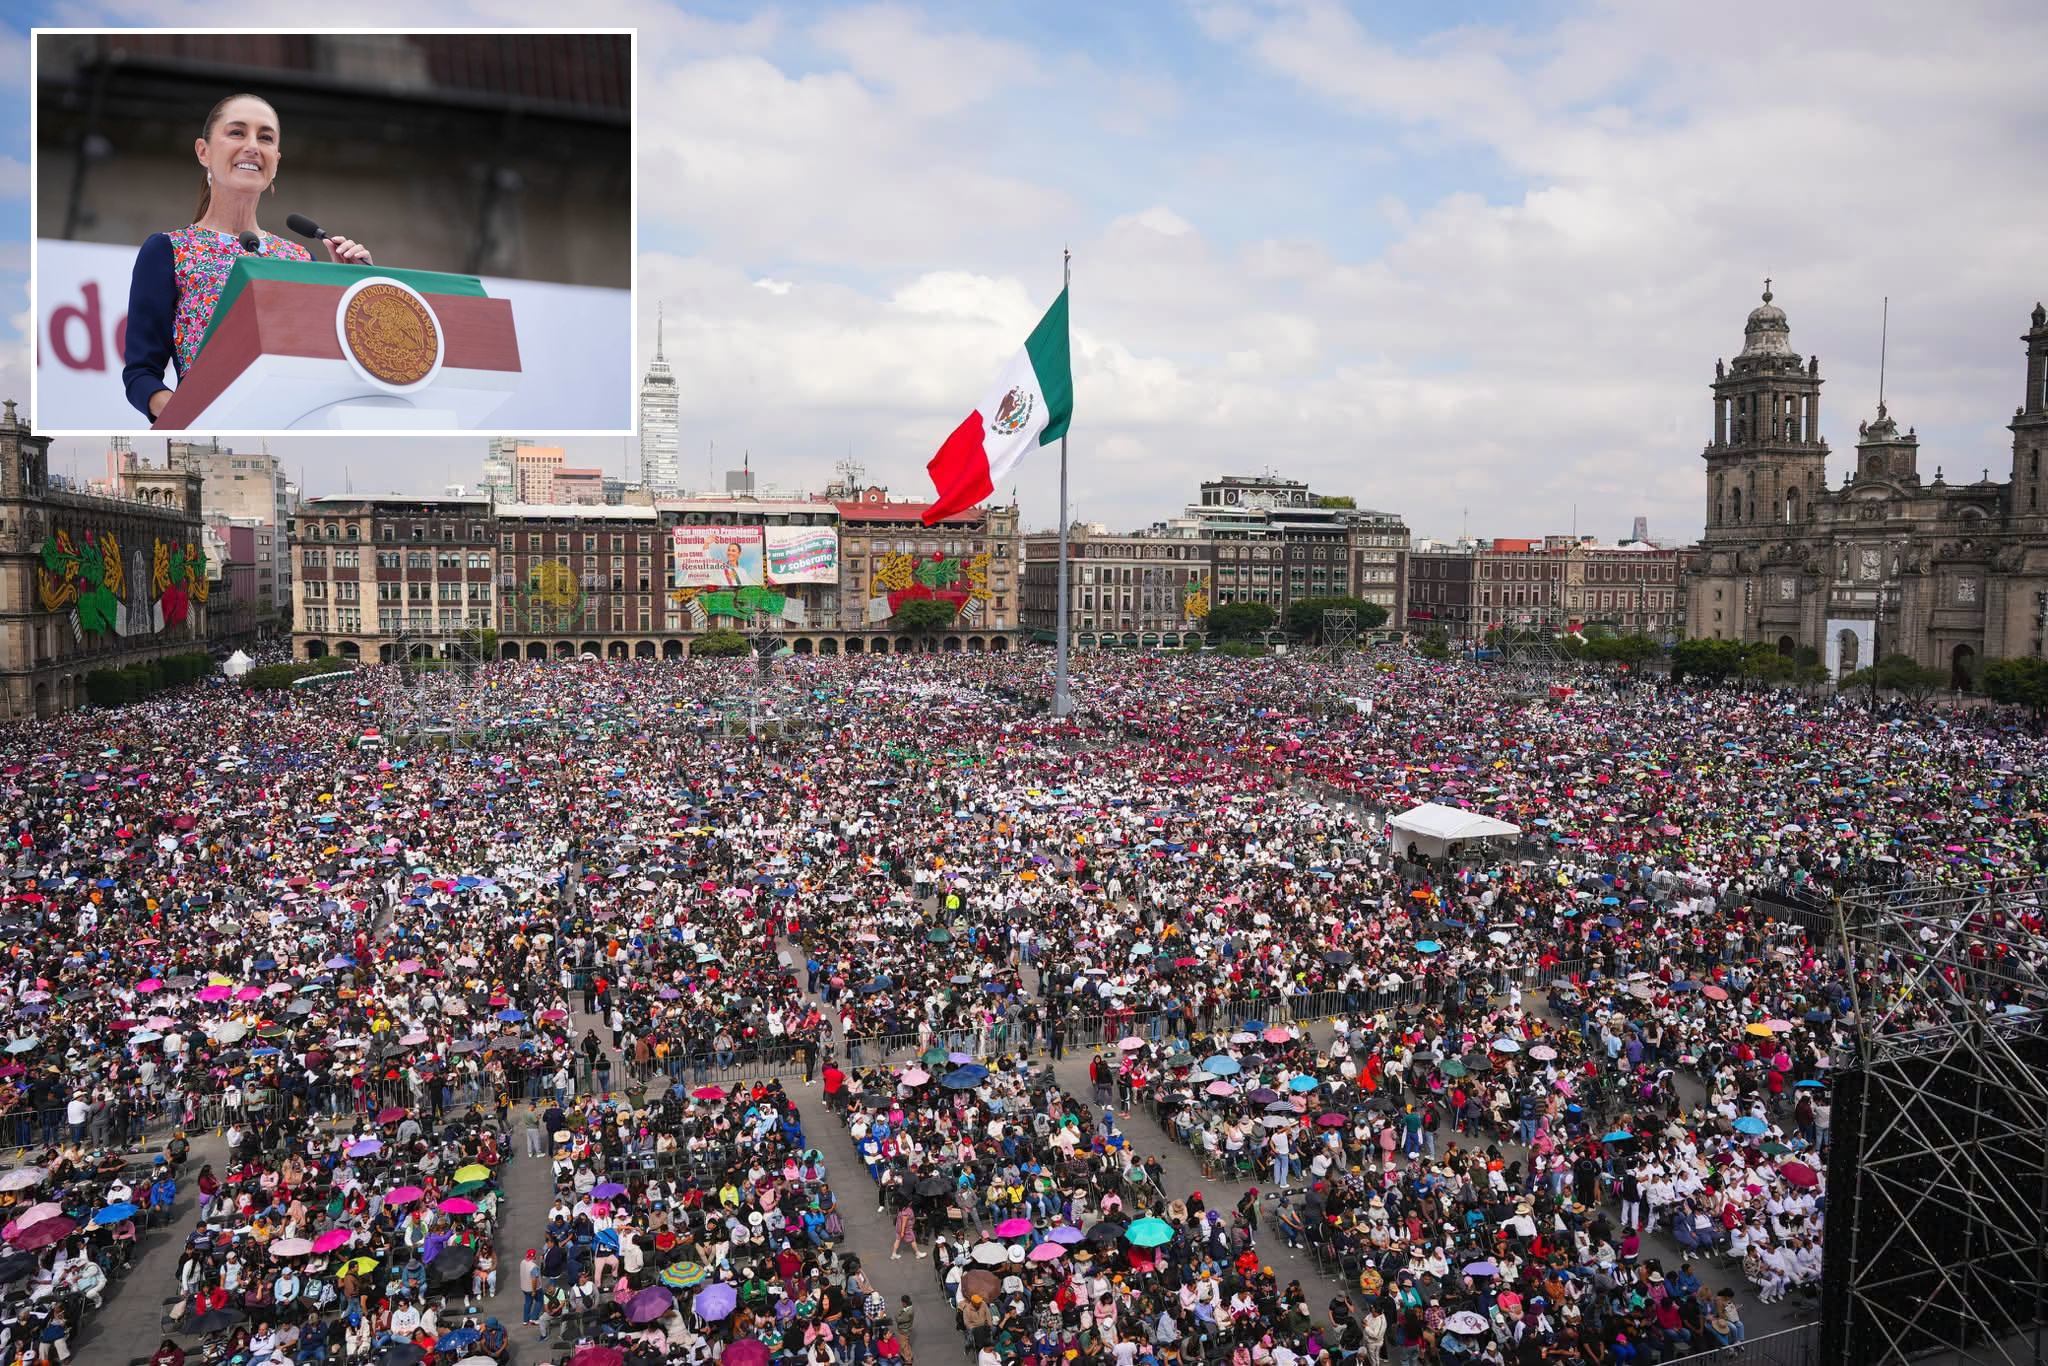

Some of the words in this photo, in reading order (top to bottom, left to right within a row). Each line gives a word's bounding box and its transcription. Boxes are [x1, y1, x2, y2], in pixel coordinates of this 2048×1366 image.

[347, 292, 366, 330] ESTADOS
[363, 285, 396, 298] UNIDOS
[396, 289, 436, 337] MEXICANOS
[675, 536, 704, 544] Claudia
[714, 536, 760, 544] Sheinbaum!
[778, 565, 786, 573] y
